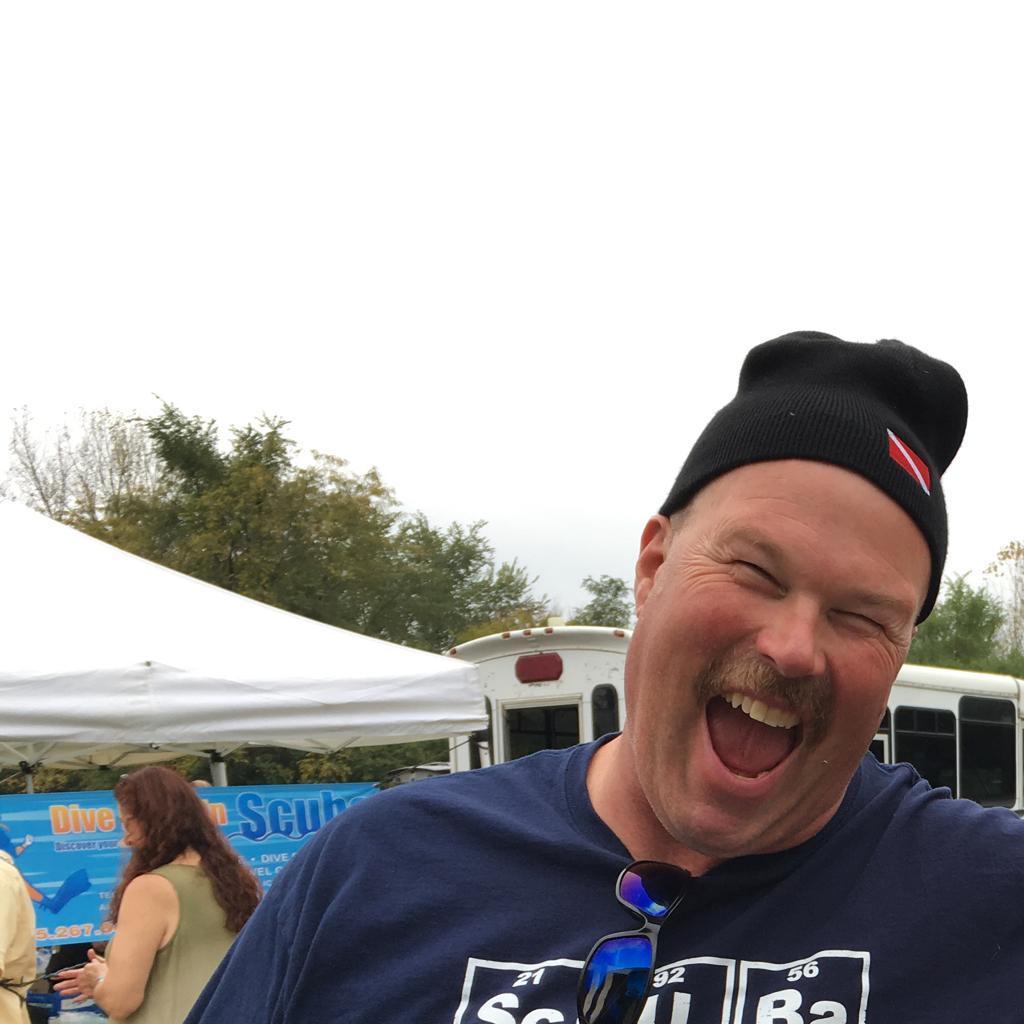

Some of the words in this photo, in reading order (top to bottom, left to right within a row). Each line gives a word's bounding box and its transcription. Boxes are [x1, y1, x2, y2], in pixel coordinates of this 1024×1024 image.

[49, 804, 116, 835] Dive
[236, 791, 368, 841] Scub
[261, 854, 289, 863] DIVE
[512, 968, 543, 987] 21
[653, 967, 686, 988] 92
[786, 961, 819, 982] 56
